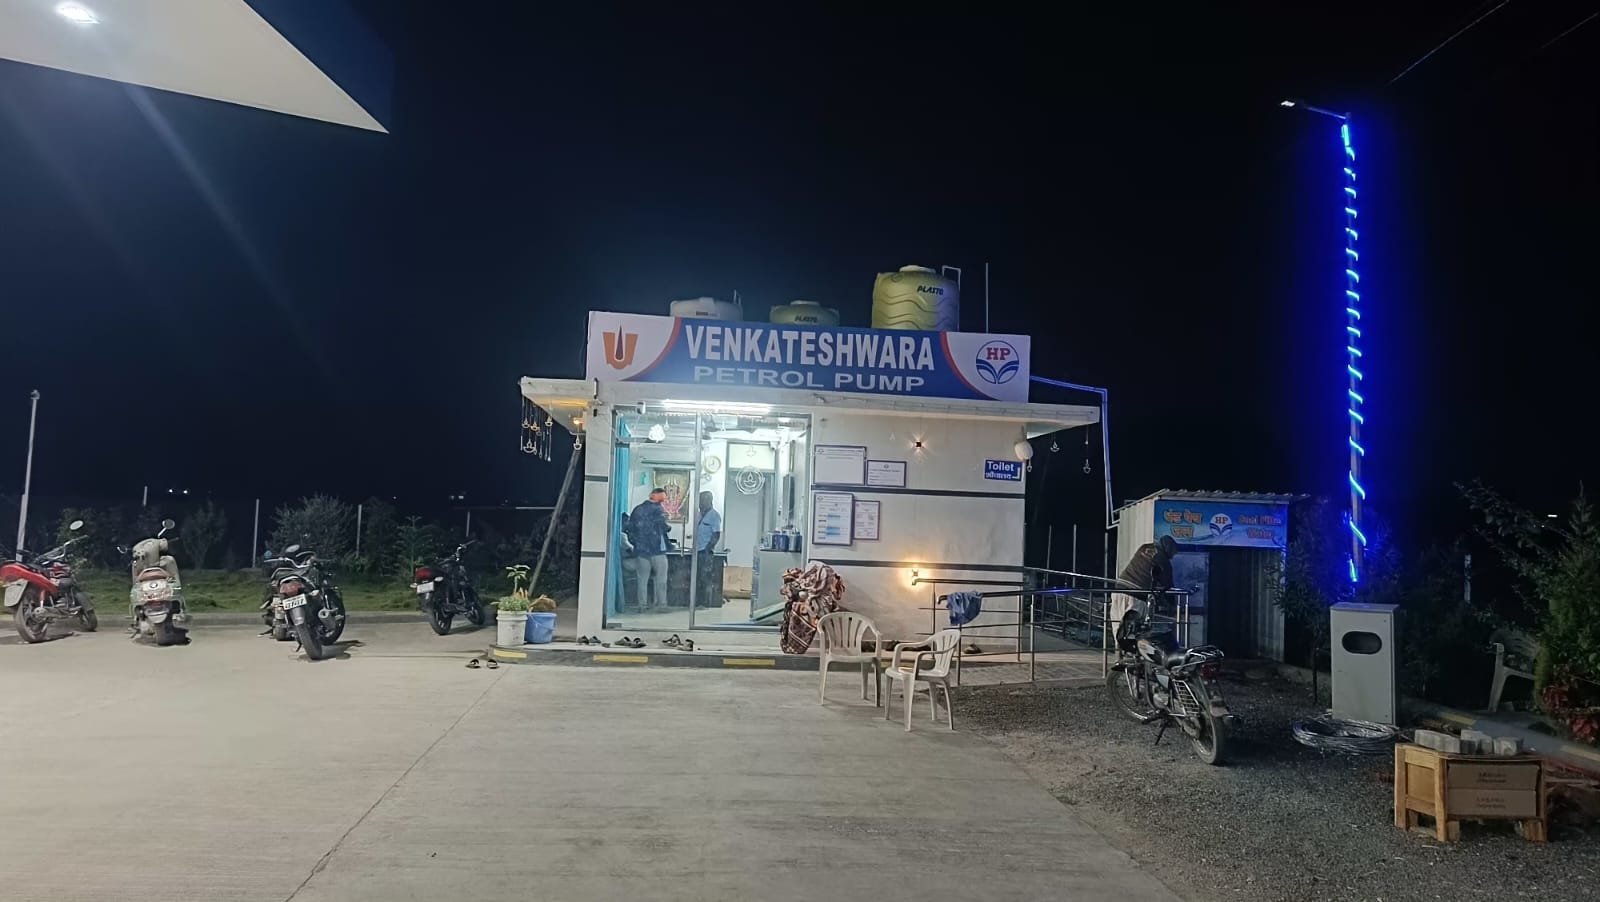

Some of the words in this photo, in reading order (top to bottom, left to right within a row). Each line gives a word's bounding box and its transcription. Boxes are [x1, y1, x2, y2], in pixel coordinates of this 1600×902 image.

[917, 285, 944, 296] PLASTO
[685, 325, 935, 371] VENKATESHWARA
[986, 347, 1011, 361] HP
[694, 366, 824, 389] PETROL
[834, 373, 926, 392] PUMP
[987, 461, 1014, 471] Toilet
[1214, 516, 1228, 524] HP
